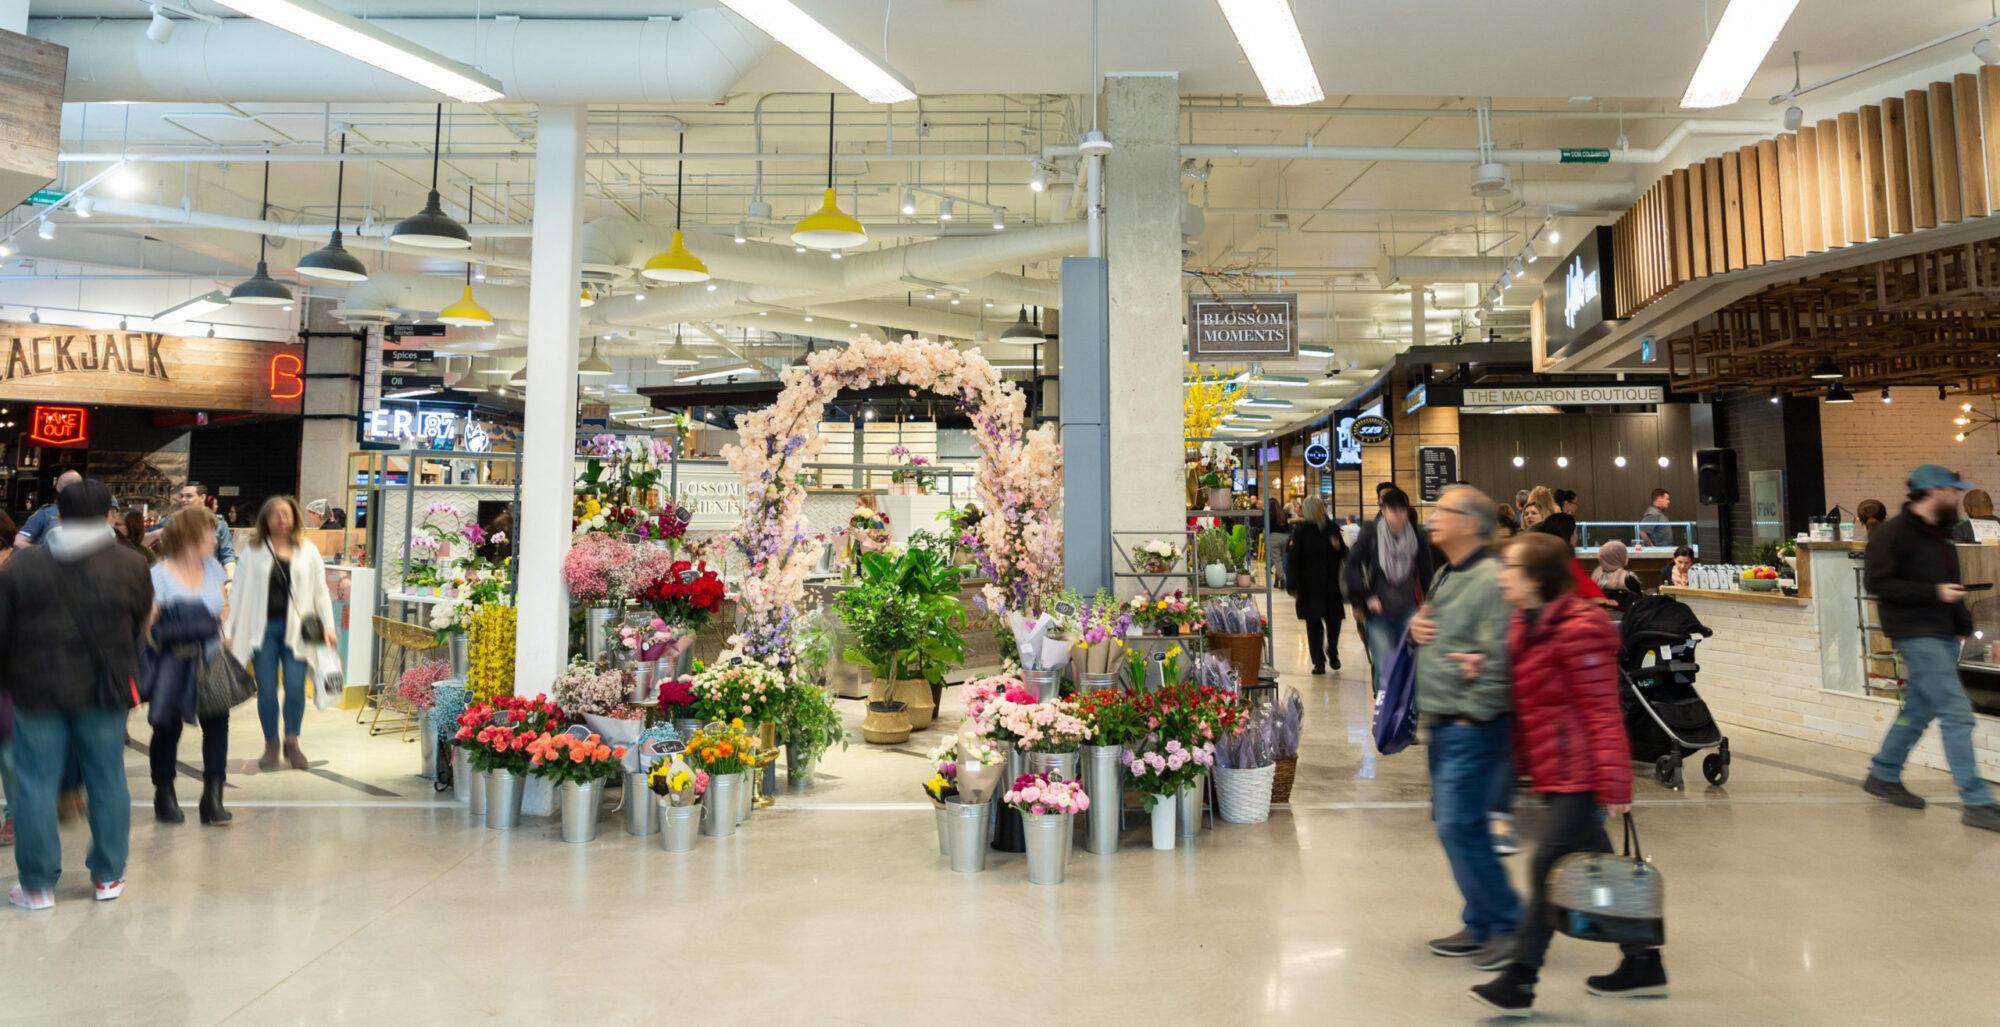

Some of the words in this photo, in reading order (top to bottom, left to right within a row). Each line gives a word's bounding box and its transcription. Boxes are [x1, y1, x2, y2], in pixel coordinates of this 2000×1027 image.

[1203, 313, 1284, 326] BLOSSOM
[1203, 330, 1284, 342] MOMENTS
[0, 333, 170, 382] ACKJACK
[392, 351, 418, 360] Spices
[391, 377, 403, 385] Oil
[1470, 390, 1498, 403] THE
[1502, 389, 1576, 402] MACARON
[1580, 388, 1659, 400] BOUTIQUE
[43, 412, 78, 426] TAKE
[43, 424, 74, 437] OUT
